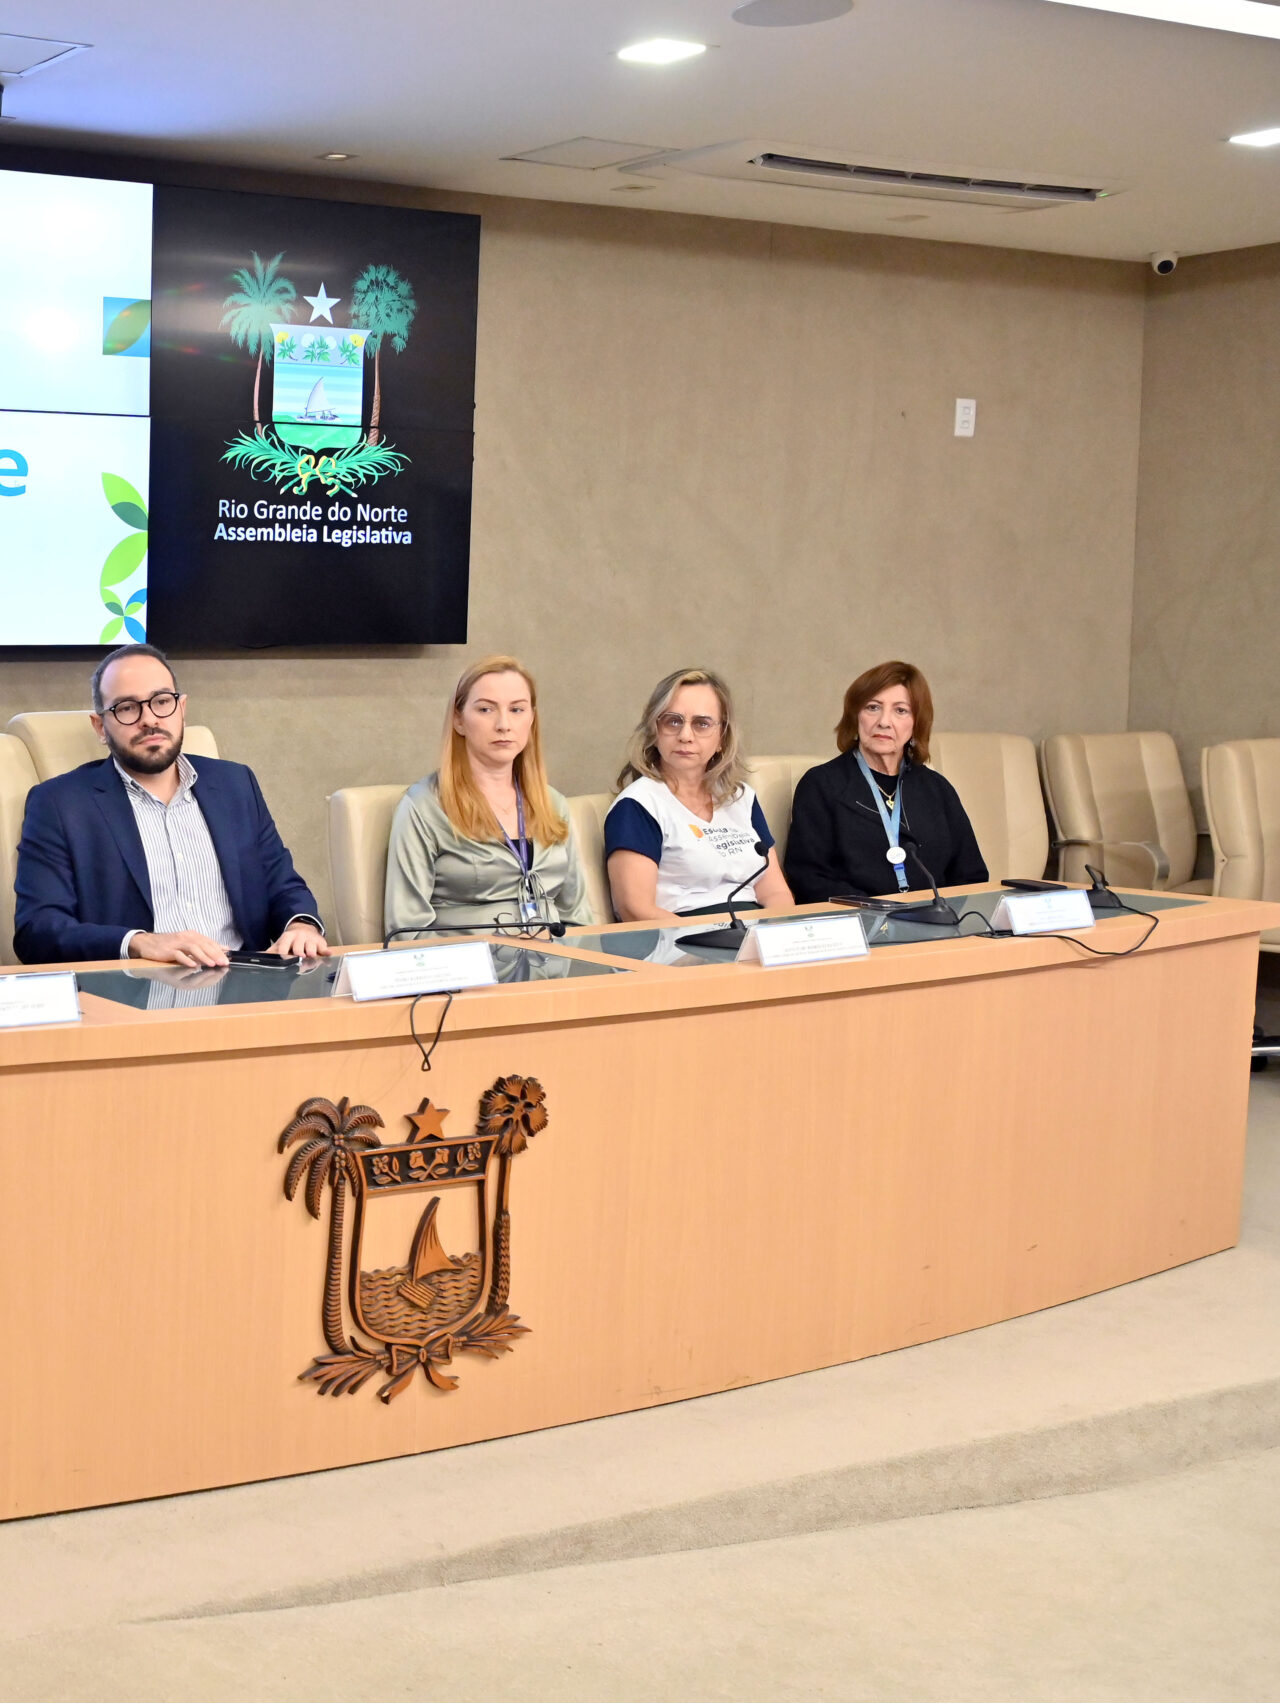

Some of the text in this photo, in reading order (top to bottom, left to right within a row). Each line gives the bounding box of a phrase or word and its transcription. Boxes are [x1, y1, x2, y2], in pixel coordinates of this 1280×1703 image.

[218, 499, 408, 523] Rio Grande do Norte
[213, 522, 412, 548] Assembleia Legislativa
